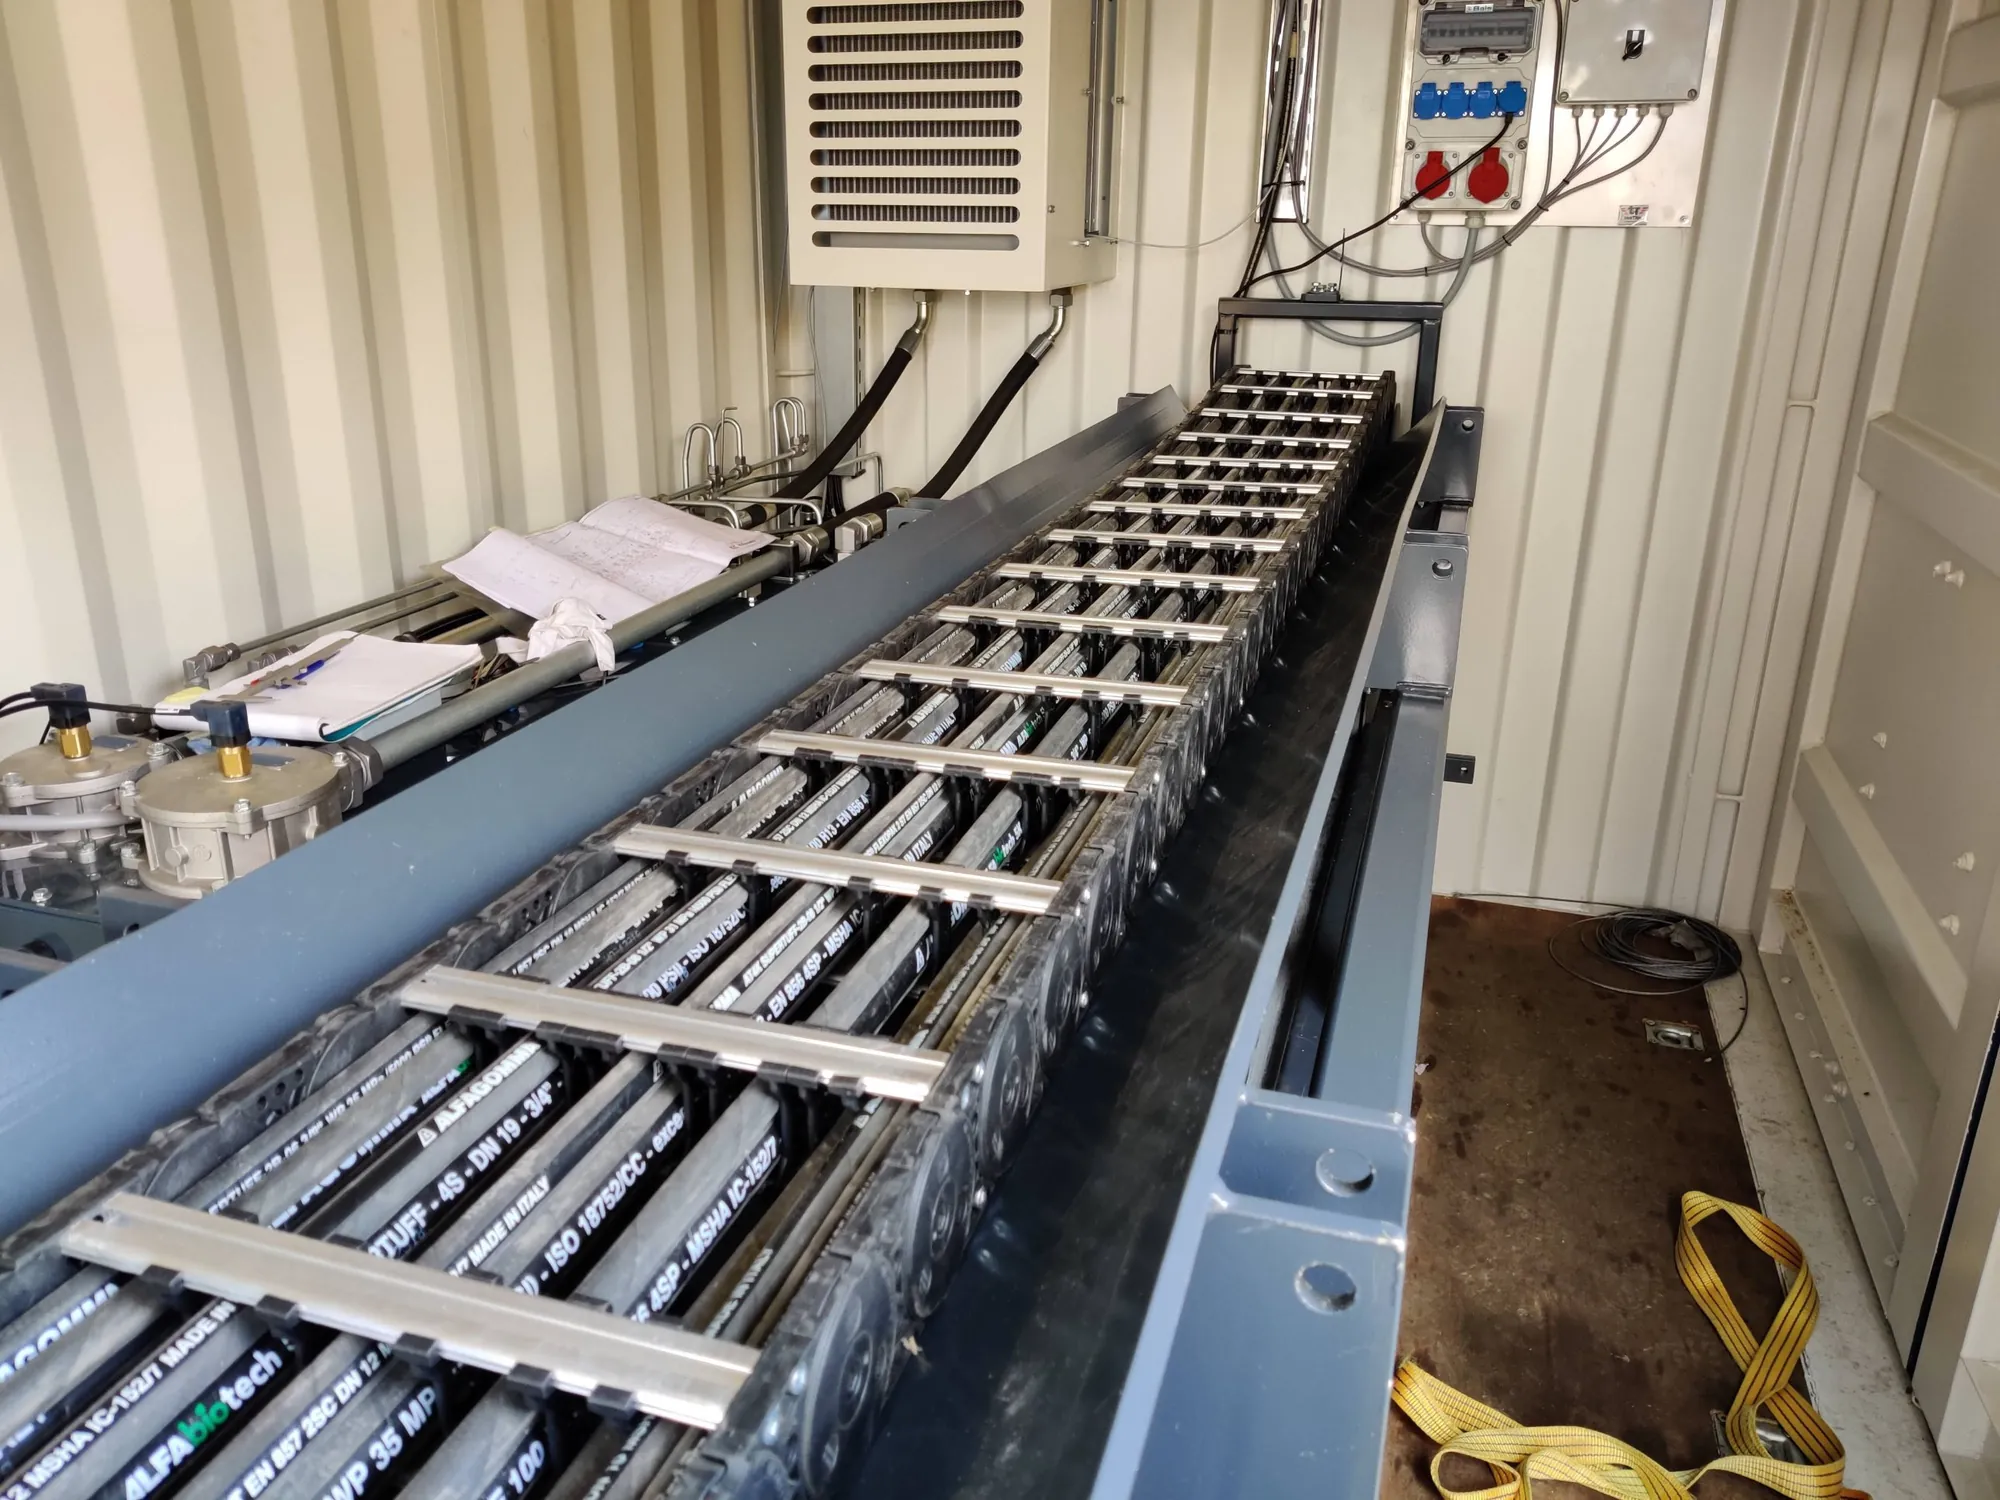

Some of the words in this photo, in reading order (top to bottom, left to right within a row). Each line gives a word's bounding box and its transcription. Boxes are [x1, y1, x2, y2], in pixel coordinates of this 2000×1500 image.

[910, 831, 933, 859] ITALY
[768, 990, 790, 1018] EN
[780, 973, 807, 1000] 856
[800, 952, 821, 980] 4SP
[824, 921, 852, 956] MSHA
[435, 1043, 540, 1132] ALFAGOMMA
[438, 1172, 464, 1201] 4S
[468, 1136, 501, 1171] DN
[497, 1118, 520, 1143] 19
[524, 1081, 552, 1118] 3/4"
[468, 1221, 507, 1266] MADE
[503, 1207, 520, 1230] IN
[516, 1175, 549, 1216] ITALY
[545, 1228, 579, 1272] ISO
[578, 1151, 646, 1235] 18752/CC
[650, 1262, 680, 1311] 4SP
[686, 1200, 735, 1263] MSHA
[727, 1136, 776, 1208] IC-152/7
[24, 1431, 94, 1488] MSHA
[85, 1363, 162, 1436] IC-152/7
[159, 1313, 218, 1367] MADE
[210, 1295, 235, 1322] IN
[123, 1350, 282, 1500] ALFAbiotech
[243, 1459, 275, 1497] EN
[271, 1428, 301, 1469] 857
[298, 1395, 337, 1438] 2SC
[333, 1369, 362, 1404] DN
[359, 1352, 379, 1376] 12
[368, 1426, 402, 1470] 35
[507, 1442, 544, 1494] 100
